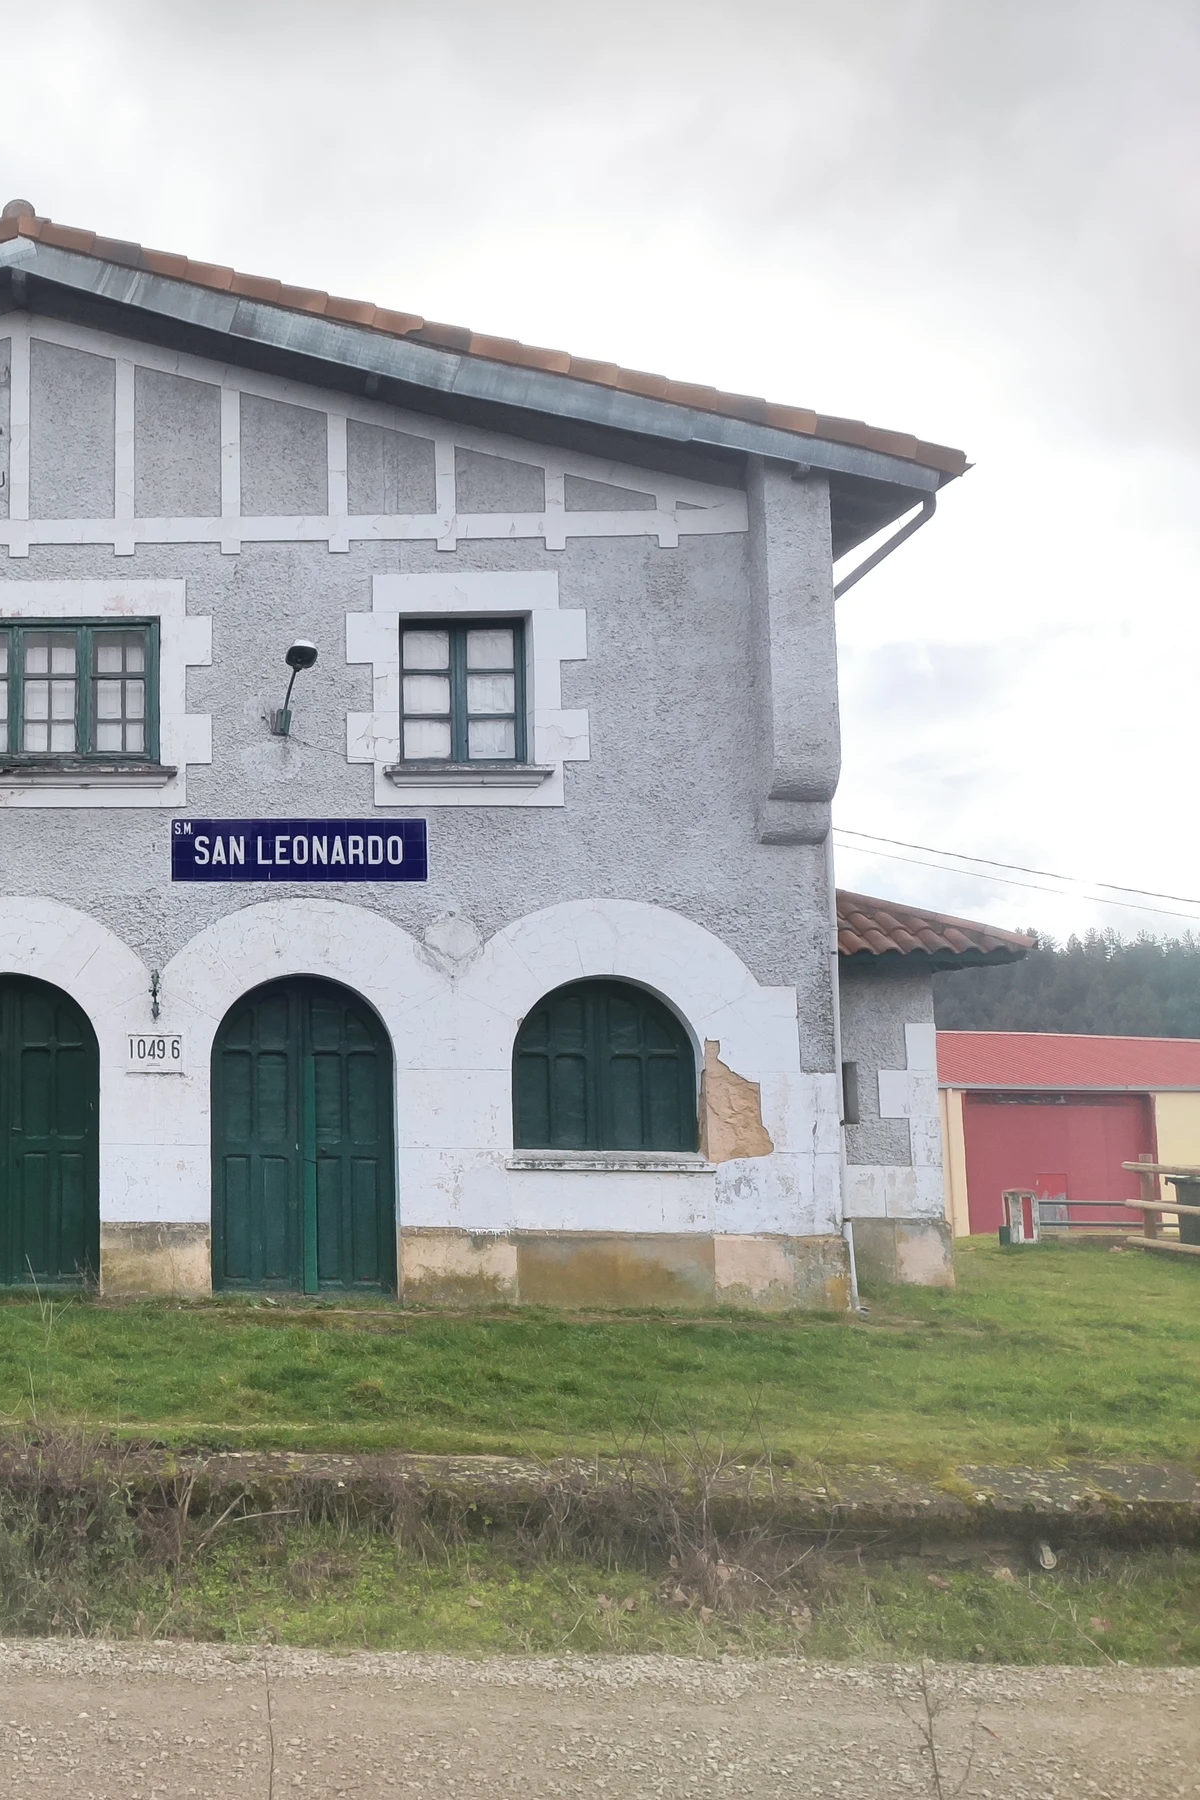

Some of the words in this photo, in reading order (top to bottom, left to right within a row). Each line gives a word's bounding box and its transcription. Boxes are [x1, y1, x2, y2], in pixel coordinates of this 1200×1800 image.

[174, 822, 194, 835] S.M.
[194, 835, 245, 865] SAN
[257, 835, 404, 865] LEONARDO
